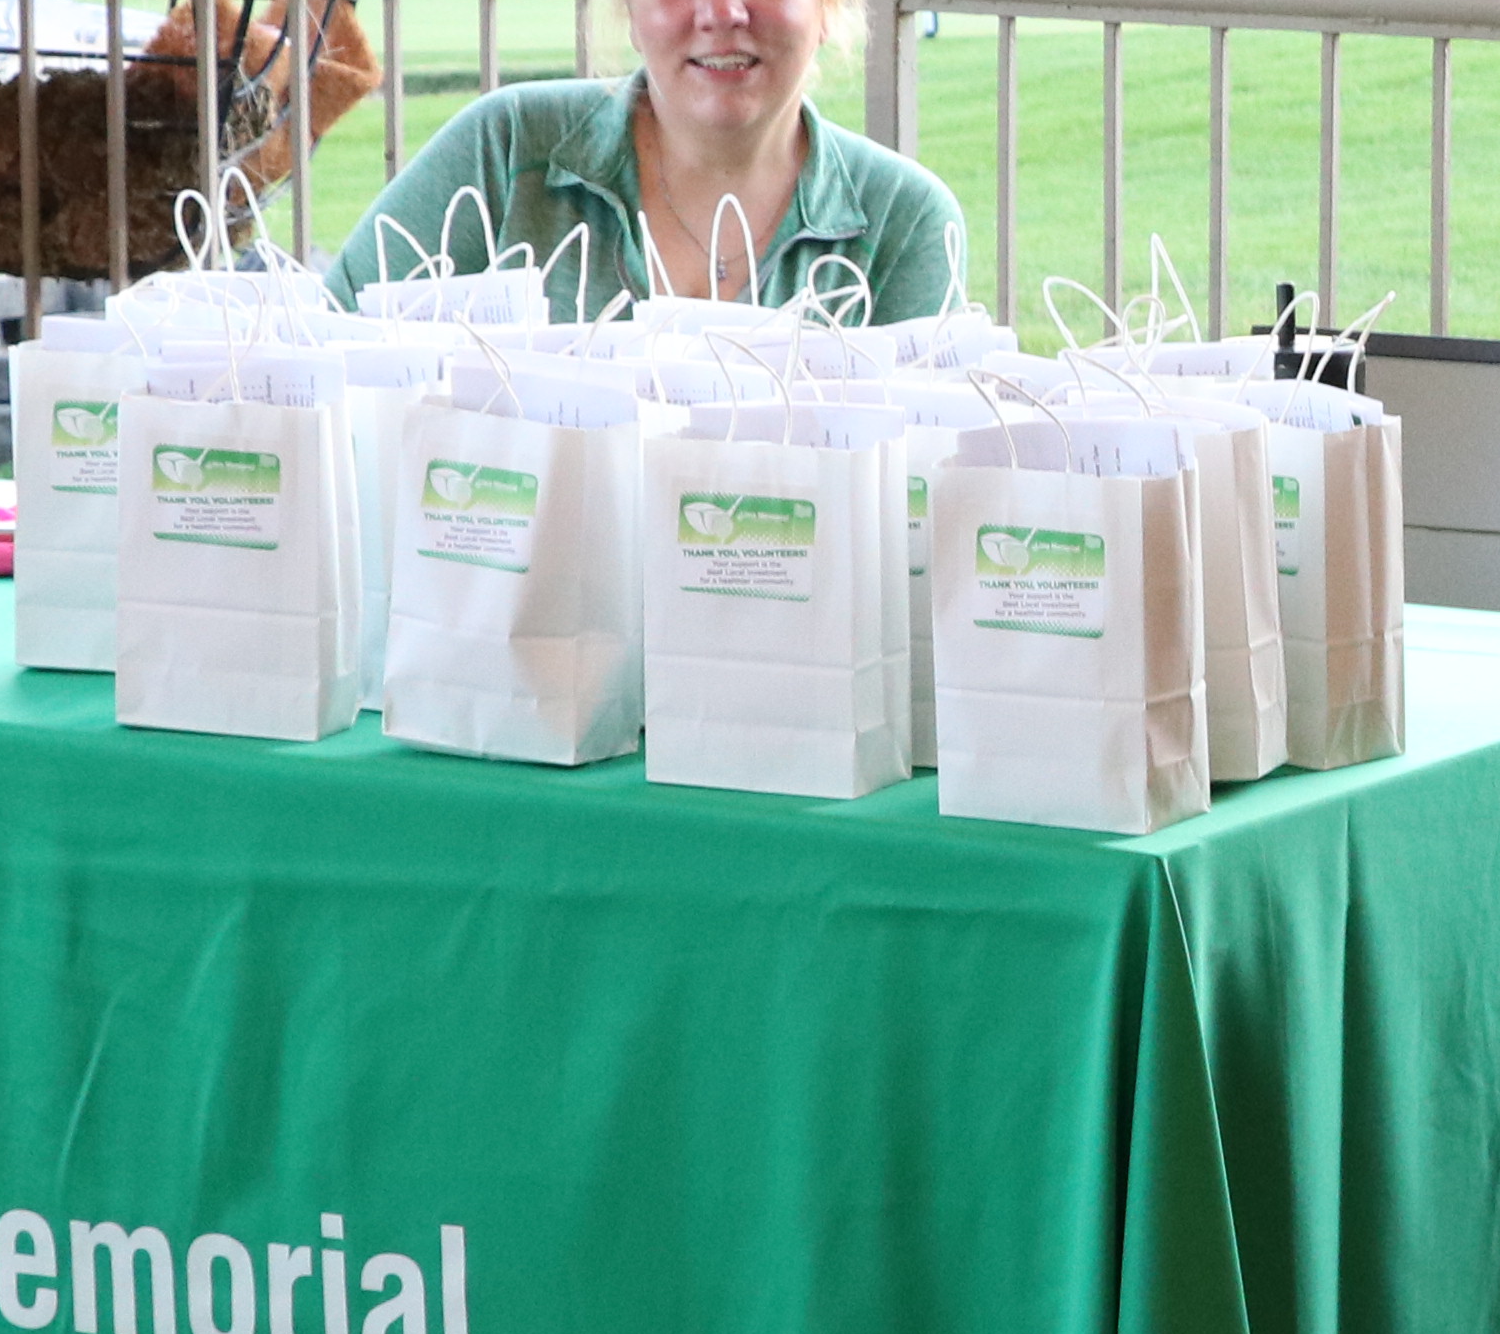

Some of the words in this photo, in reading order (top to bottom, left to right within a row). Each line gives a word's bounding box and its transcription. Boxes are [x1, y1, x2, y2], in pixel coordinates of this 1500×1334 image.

[682, 549, 715, 558] THANK
[979, 580, 1011, 589] THANK
[1036, 581, 1099, 590] VOLUNTEERS!
